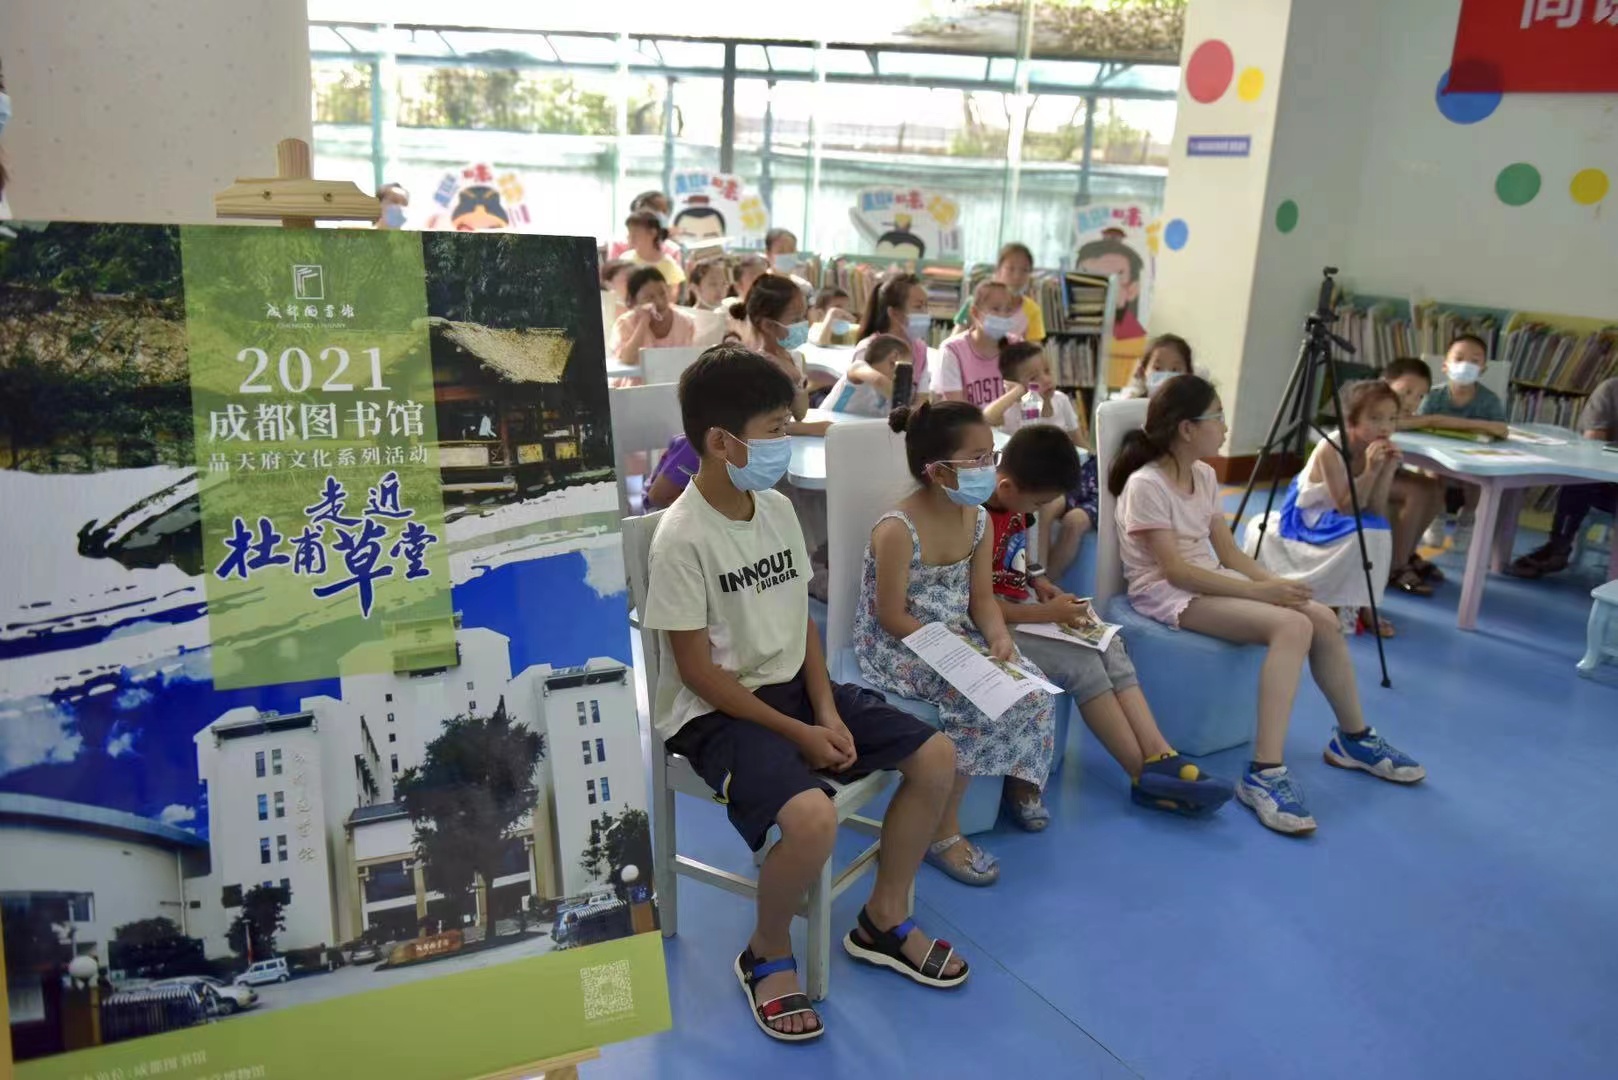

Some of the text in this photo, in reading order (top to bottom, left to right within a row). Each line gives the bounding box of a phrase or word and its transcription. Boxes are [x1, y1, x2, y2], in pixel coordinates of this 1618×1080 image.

[236, 346, 392, 394] 2021
[208, 399, 425, 443] 成都图书馆
[208, 445, 429, 473] 品天府文化系列活动
[305, 472, 412, 527] 走近
[214, 515, 438, 619] 杜甫草堂
